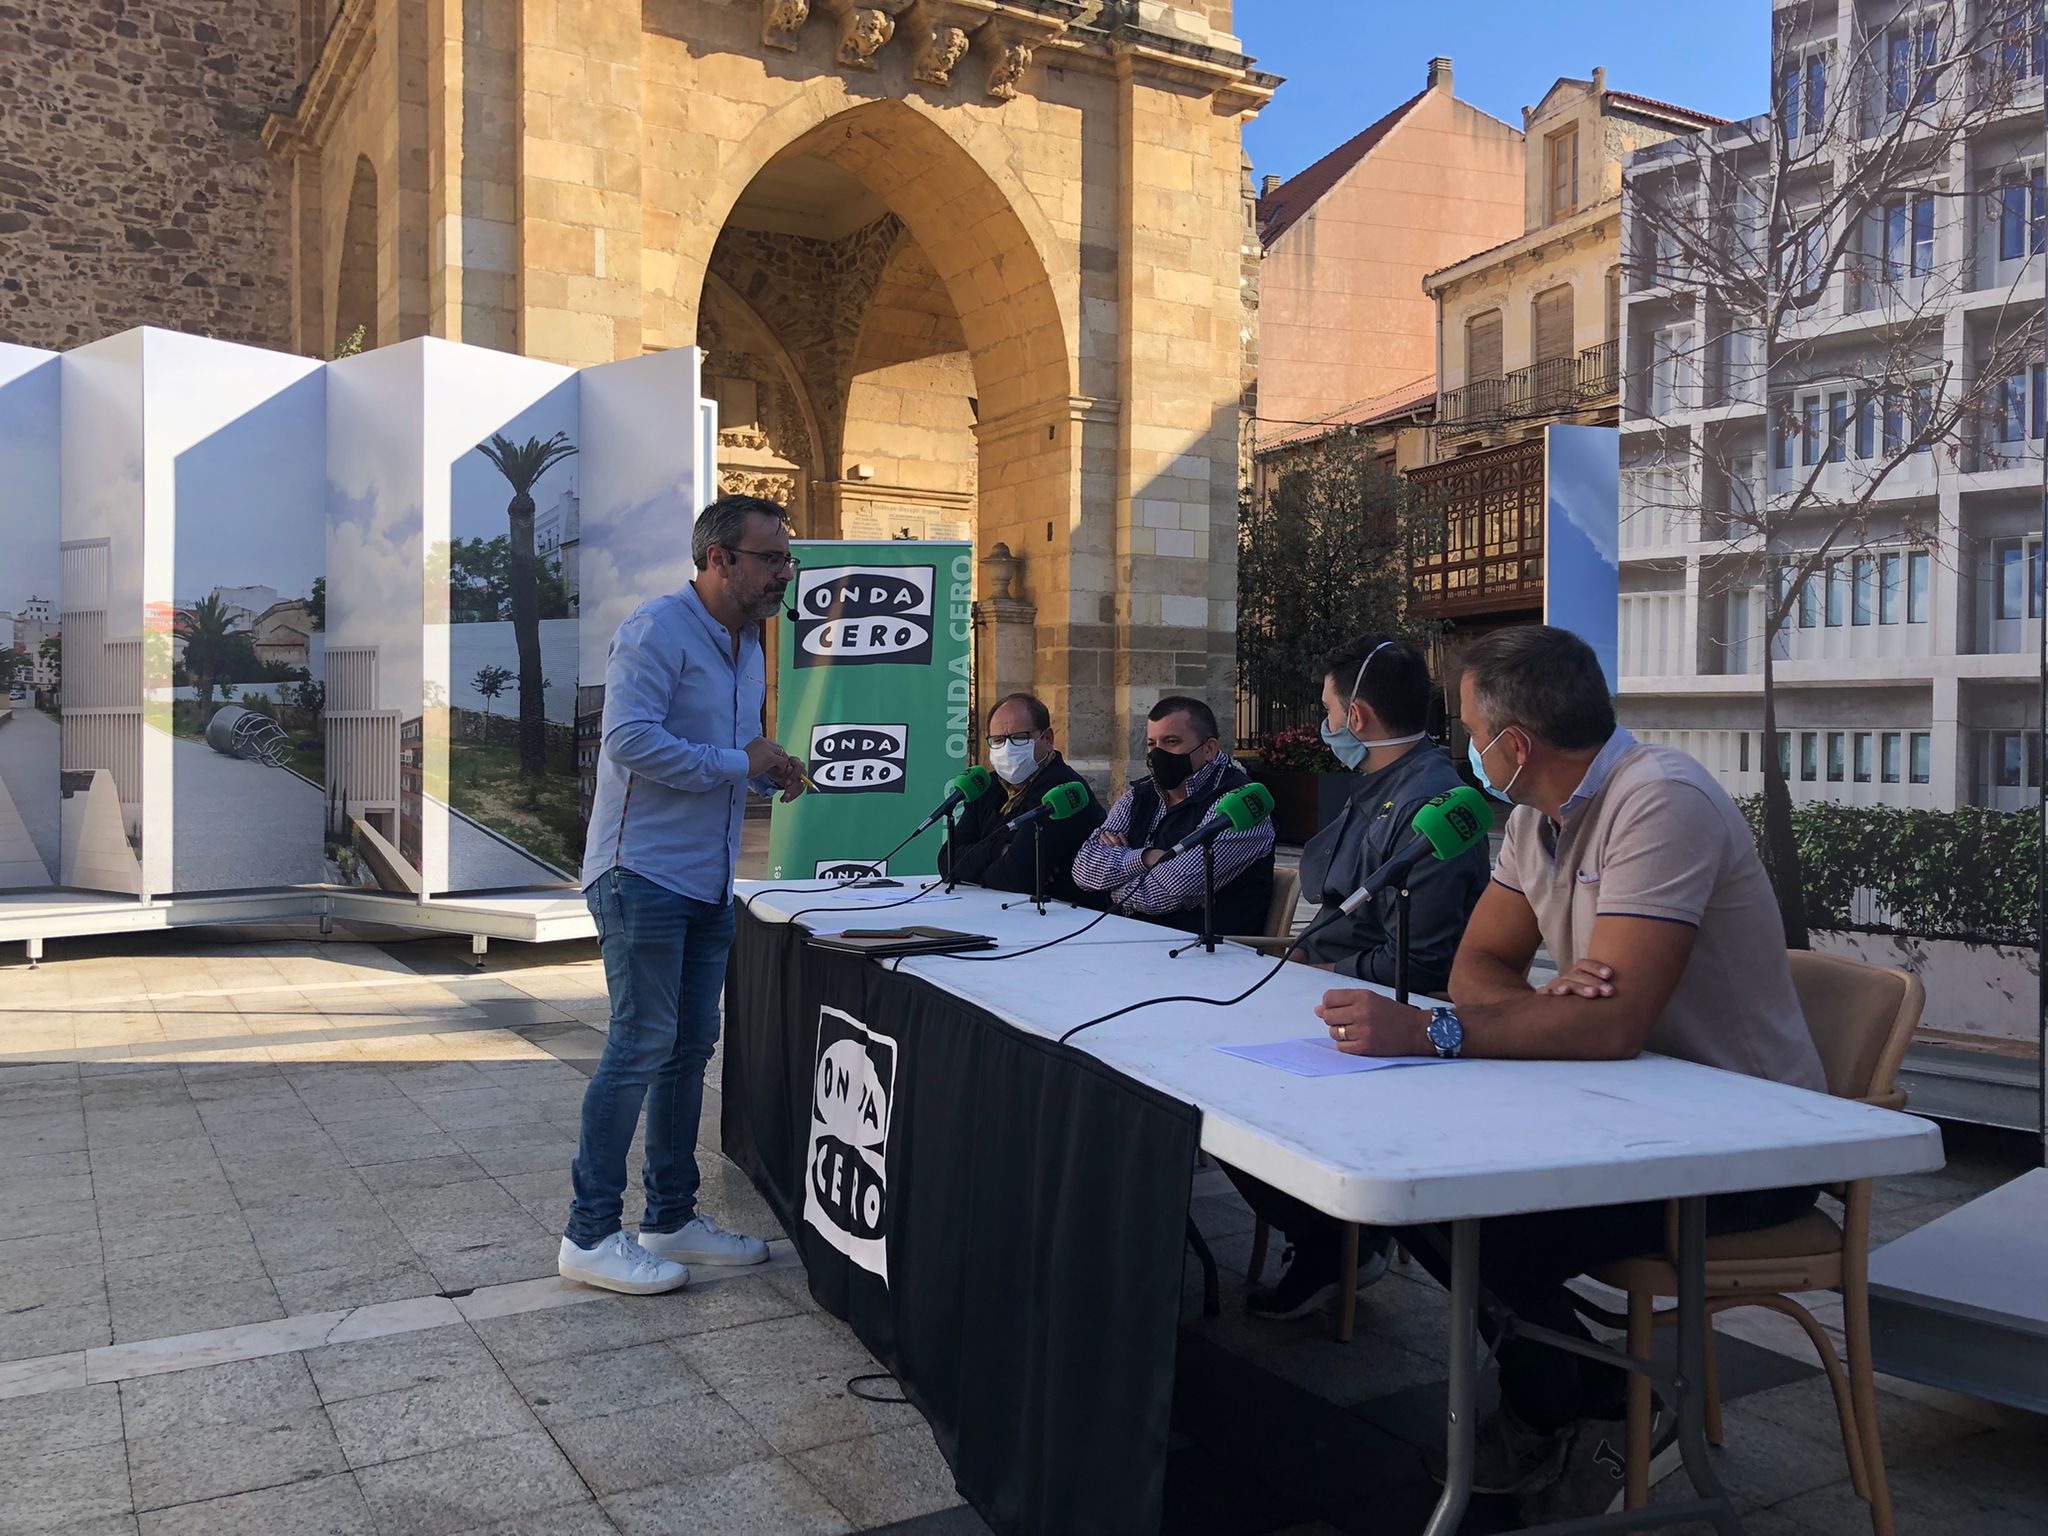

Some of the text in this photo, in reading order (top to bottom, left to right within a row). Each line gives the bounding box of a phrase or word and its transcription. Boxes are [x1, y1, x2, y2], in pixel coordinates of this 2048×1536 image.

[815, 586, 912, 608] ONDA
[949, 554, 972, 642] CERO
[819, 624, 912, 648] CERO
[945, 654, 971, 759] ONDA
[823, 738, 892, 753] ONDA
[825, 765, 891, 781] CERO
